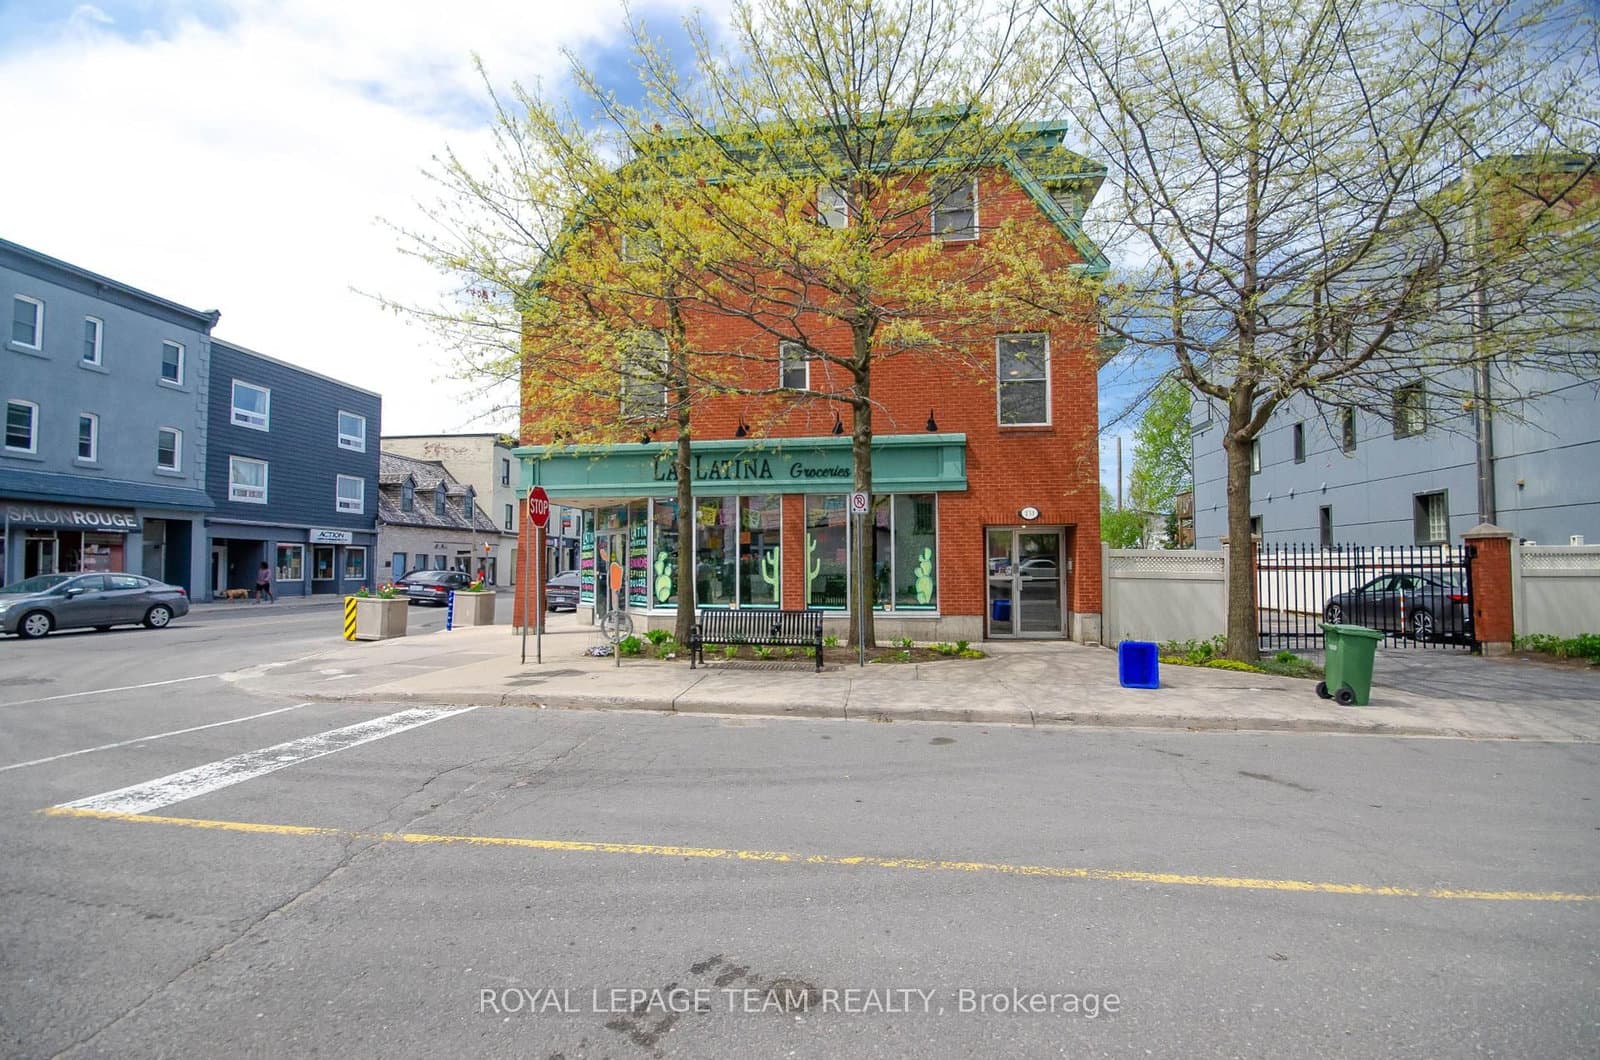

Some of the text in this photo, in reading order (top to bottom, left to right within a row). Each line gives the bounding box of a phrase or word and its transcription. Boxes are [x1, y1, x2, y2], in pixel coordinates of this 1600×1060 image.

[694, 455, 773, 480] LATINA
[790, 462, 850, 478] Groceries
[530, 498, 549, 515] STOP
